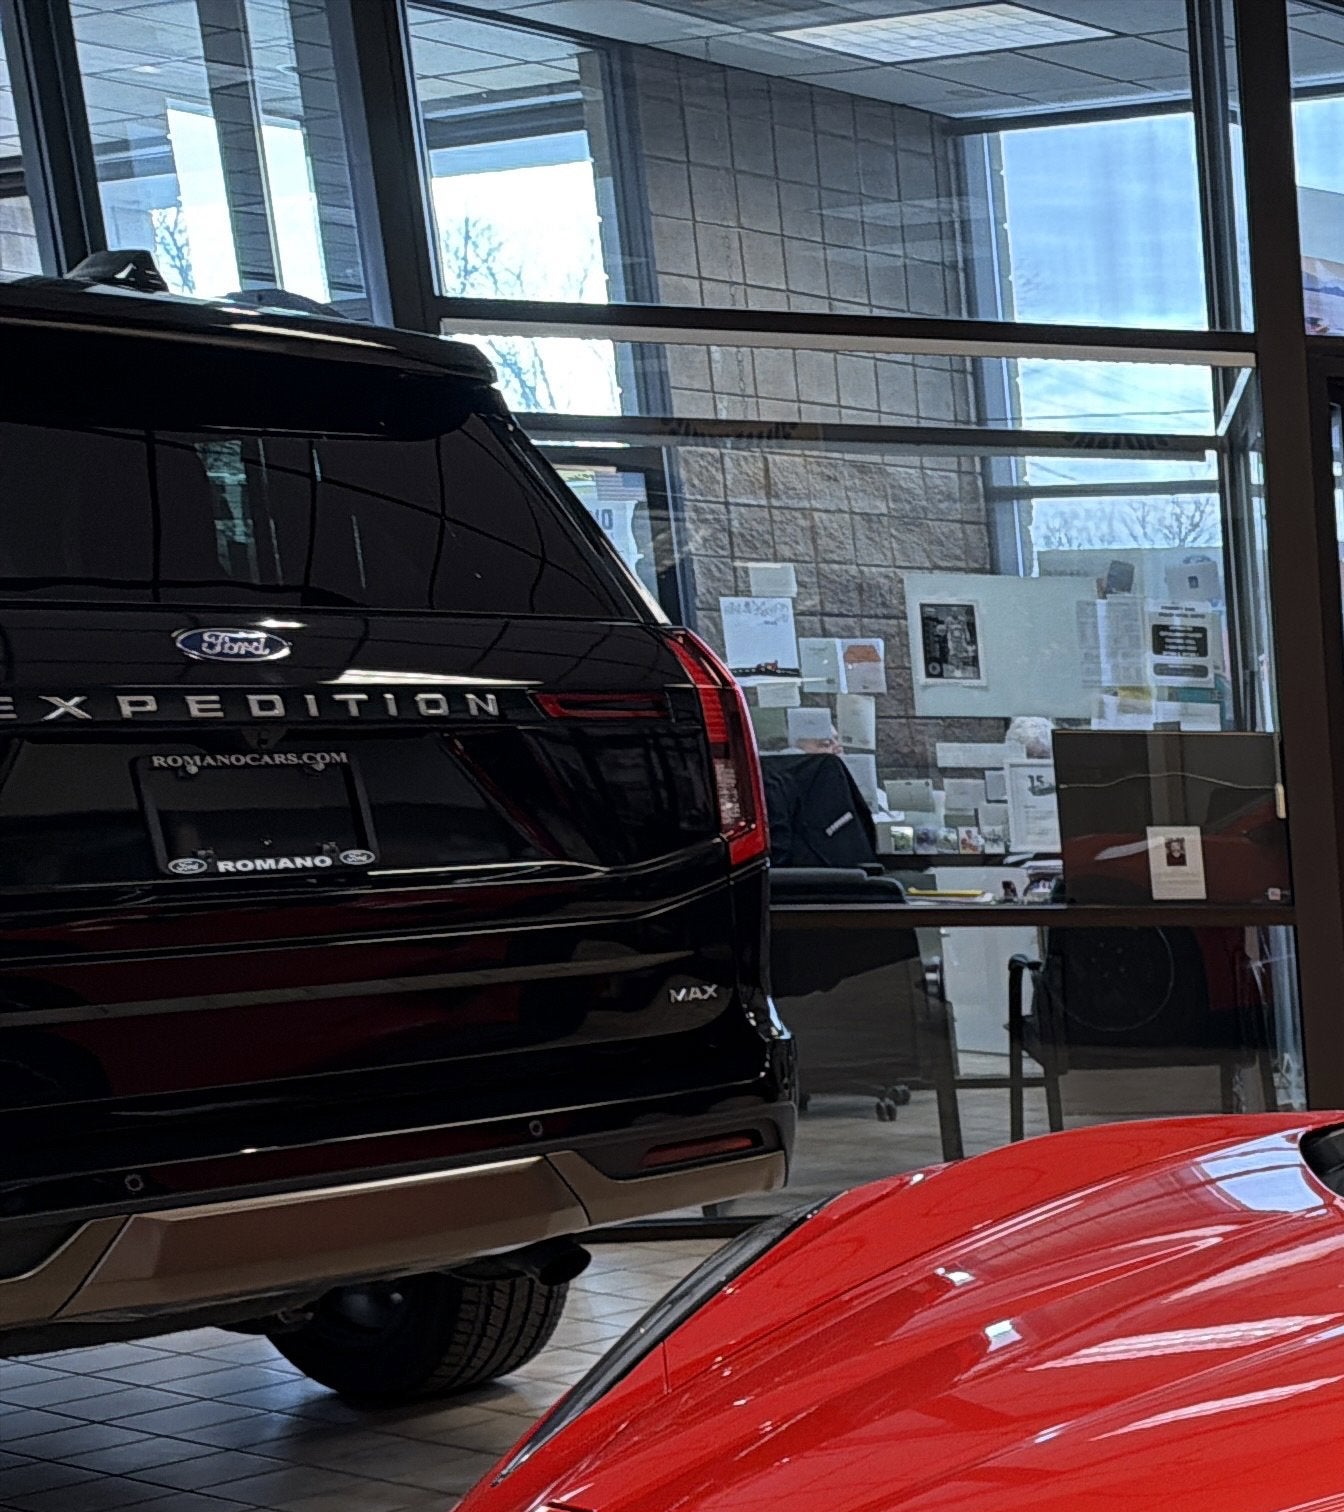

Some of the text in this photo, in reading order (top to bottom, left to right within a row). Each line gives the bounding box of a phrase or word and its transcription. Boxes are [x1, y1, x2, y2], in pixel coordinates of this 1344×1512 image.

[151, 751, 348, 768] ROMANOCARS.COM
[216, 856, 333, 873] ROMANO
[668, 982, 718, 1004] MAX
